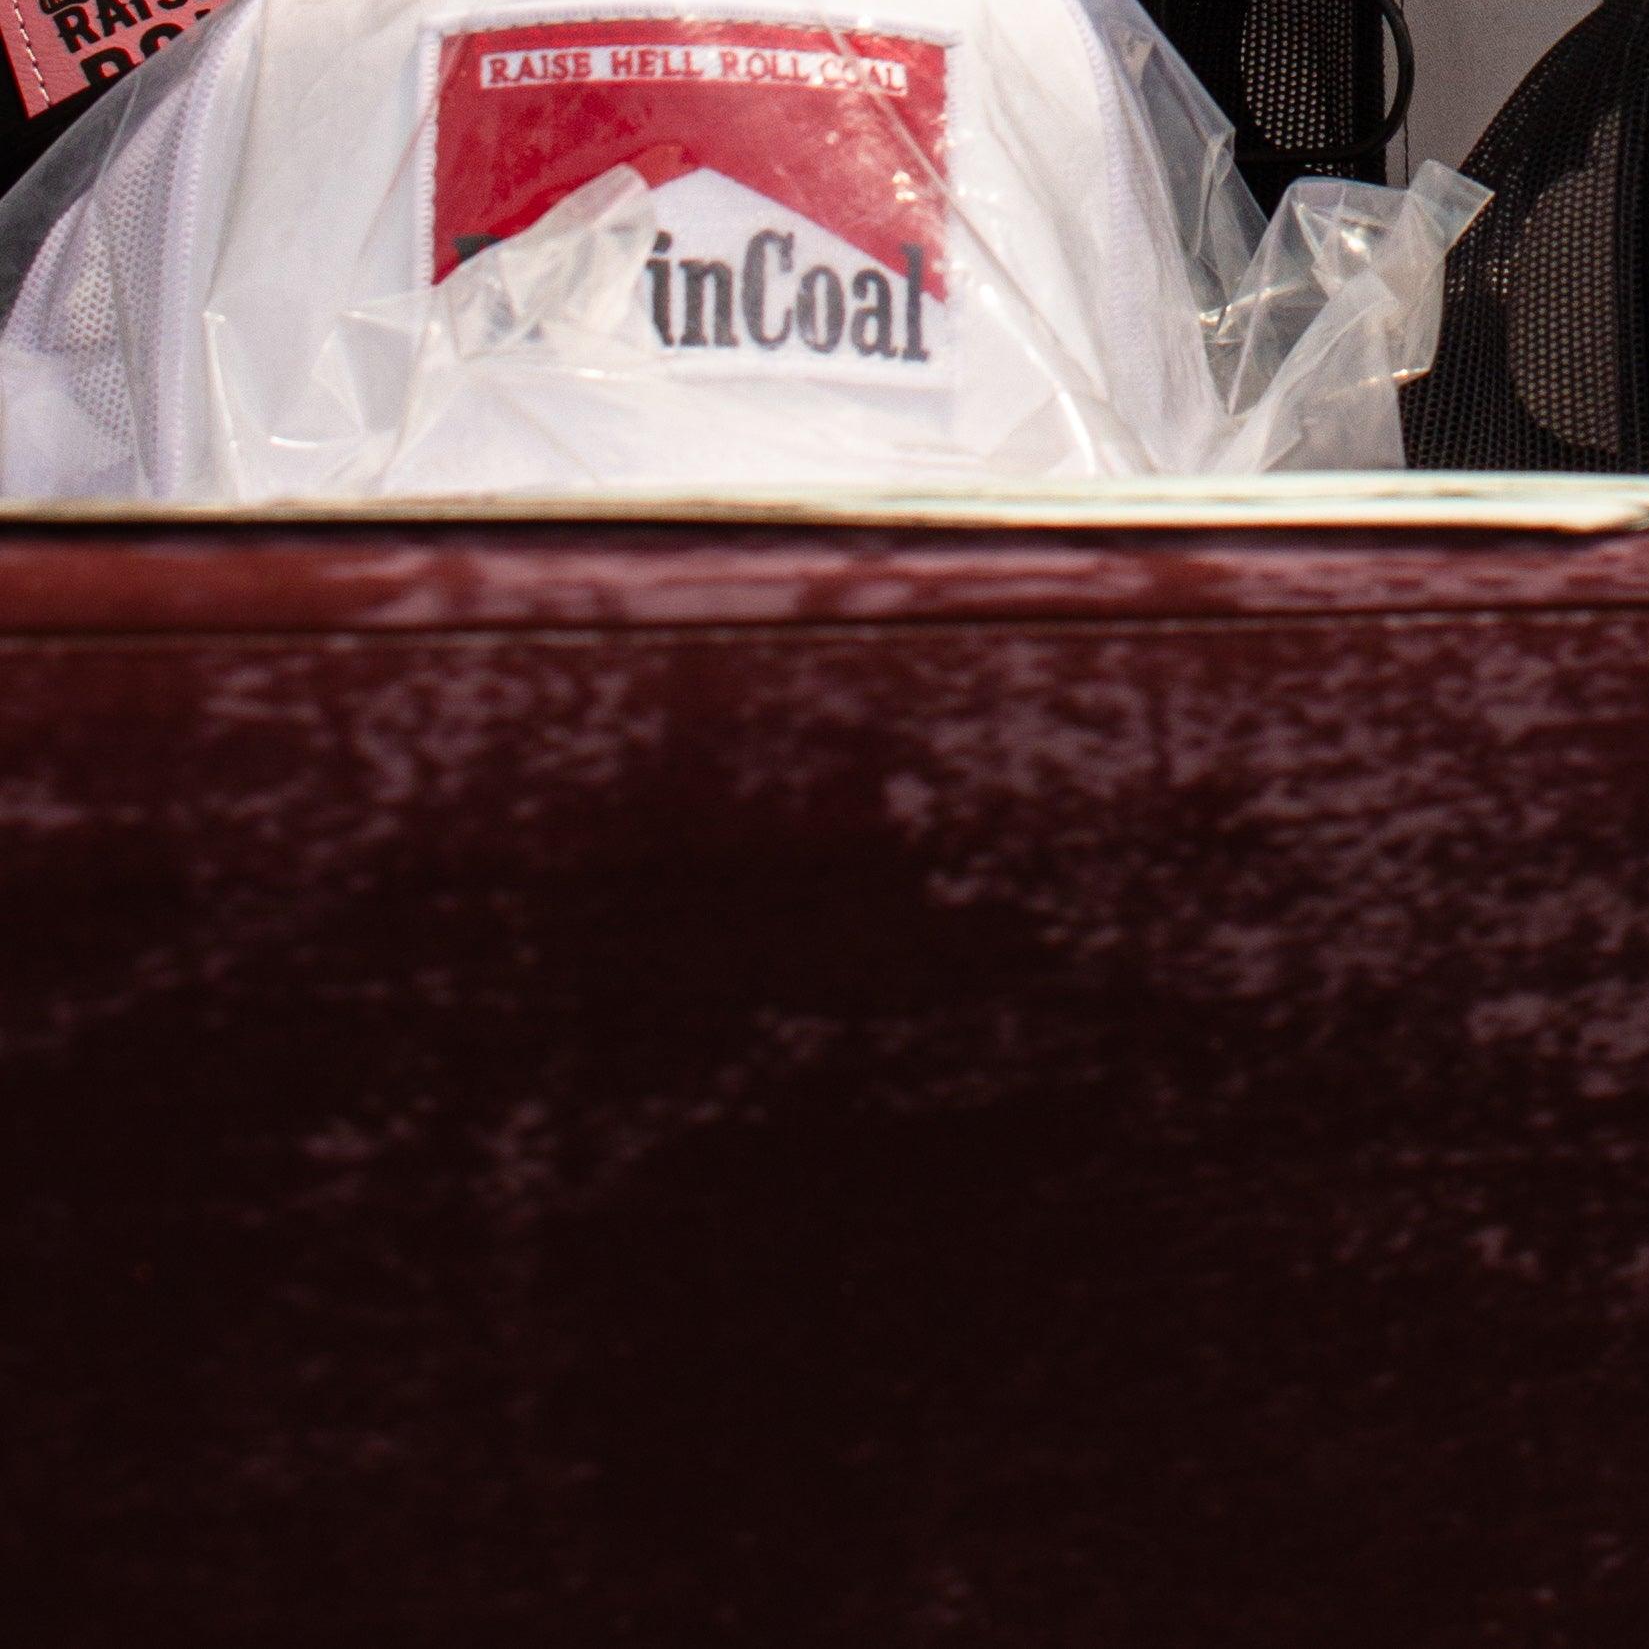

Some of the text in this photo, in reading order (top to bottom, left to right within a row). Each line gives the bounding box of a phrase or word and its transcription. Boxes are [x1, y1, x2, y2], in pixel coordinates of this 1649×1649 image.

[487, 51, 592, 84] RAISE
[610, 48, 704, 80] HELL
[720, 50, 811, 83] ROLL
